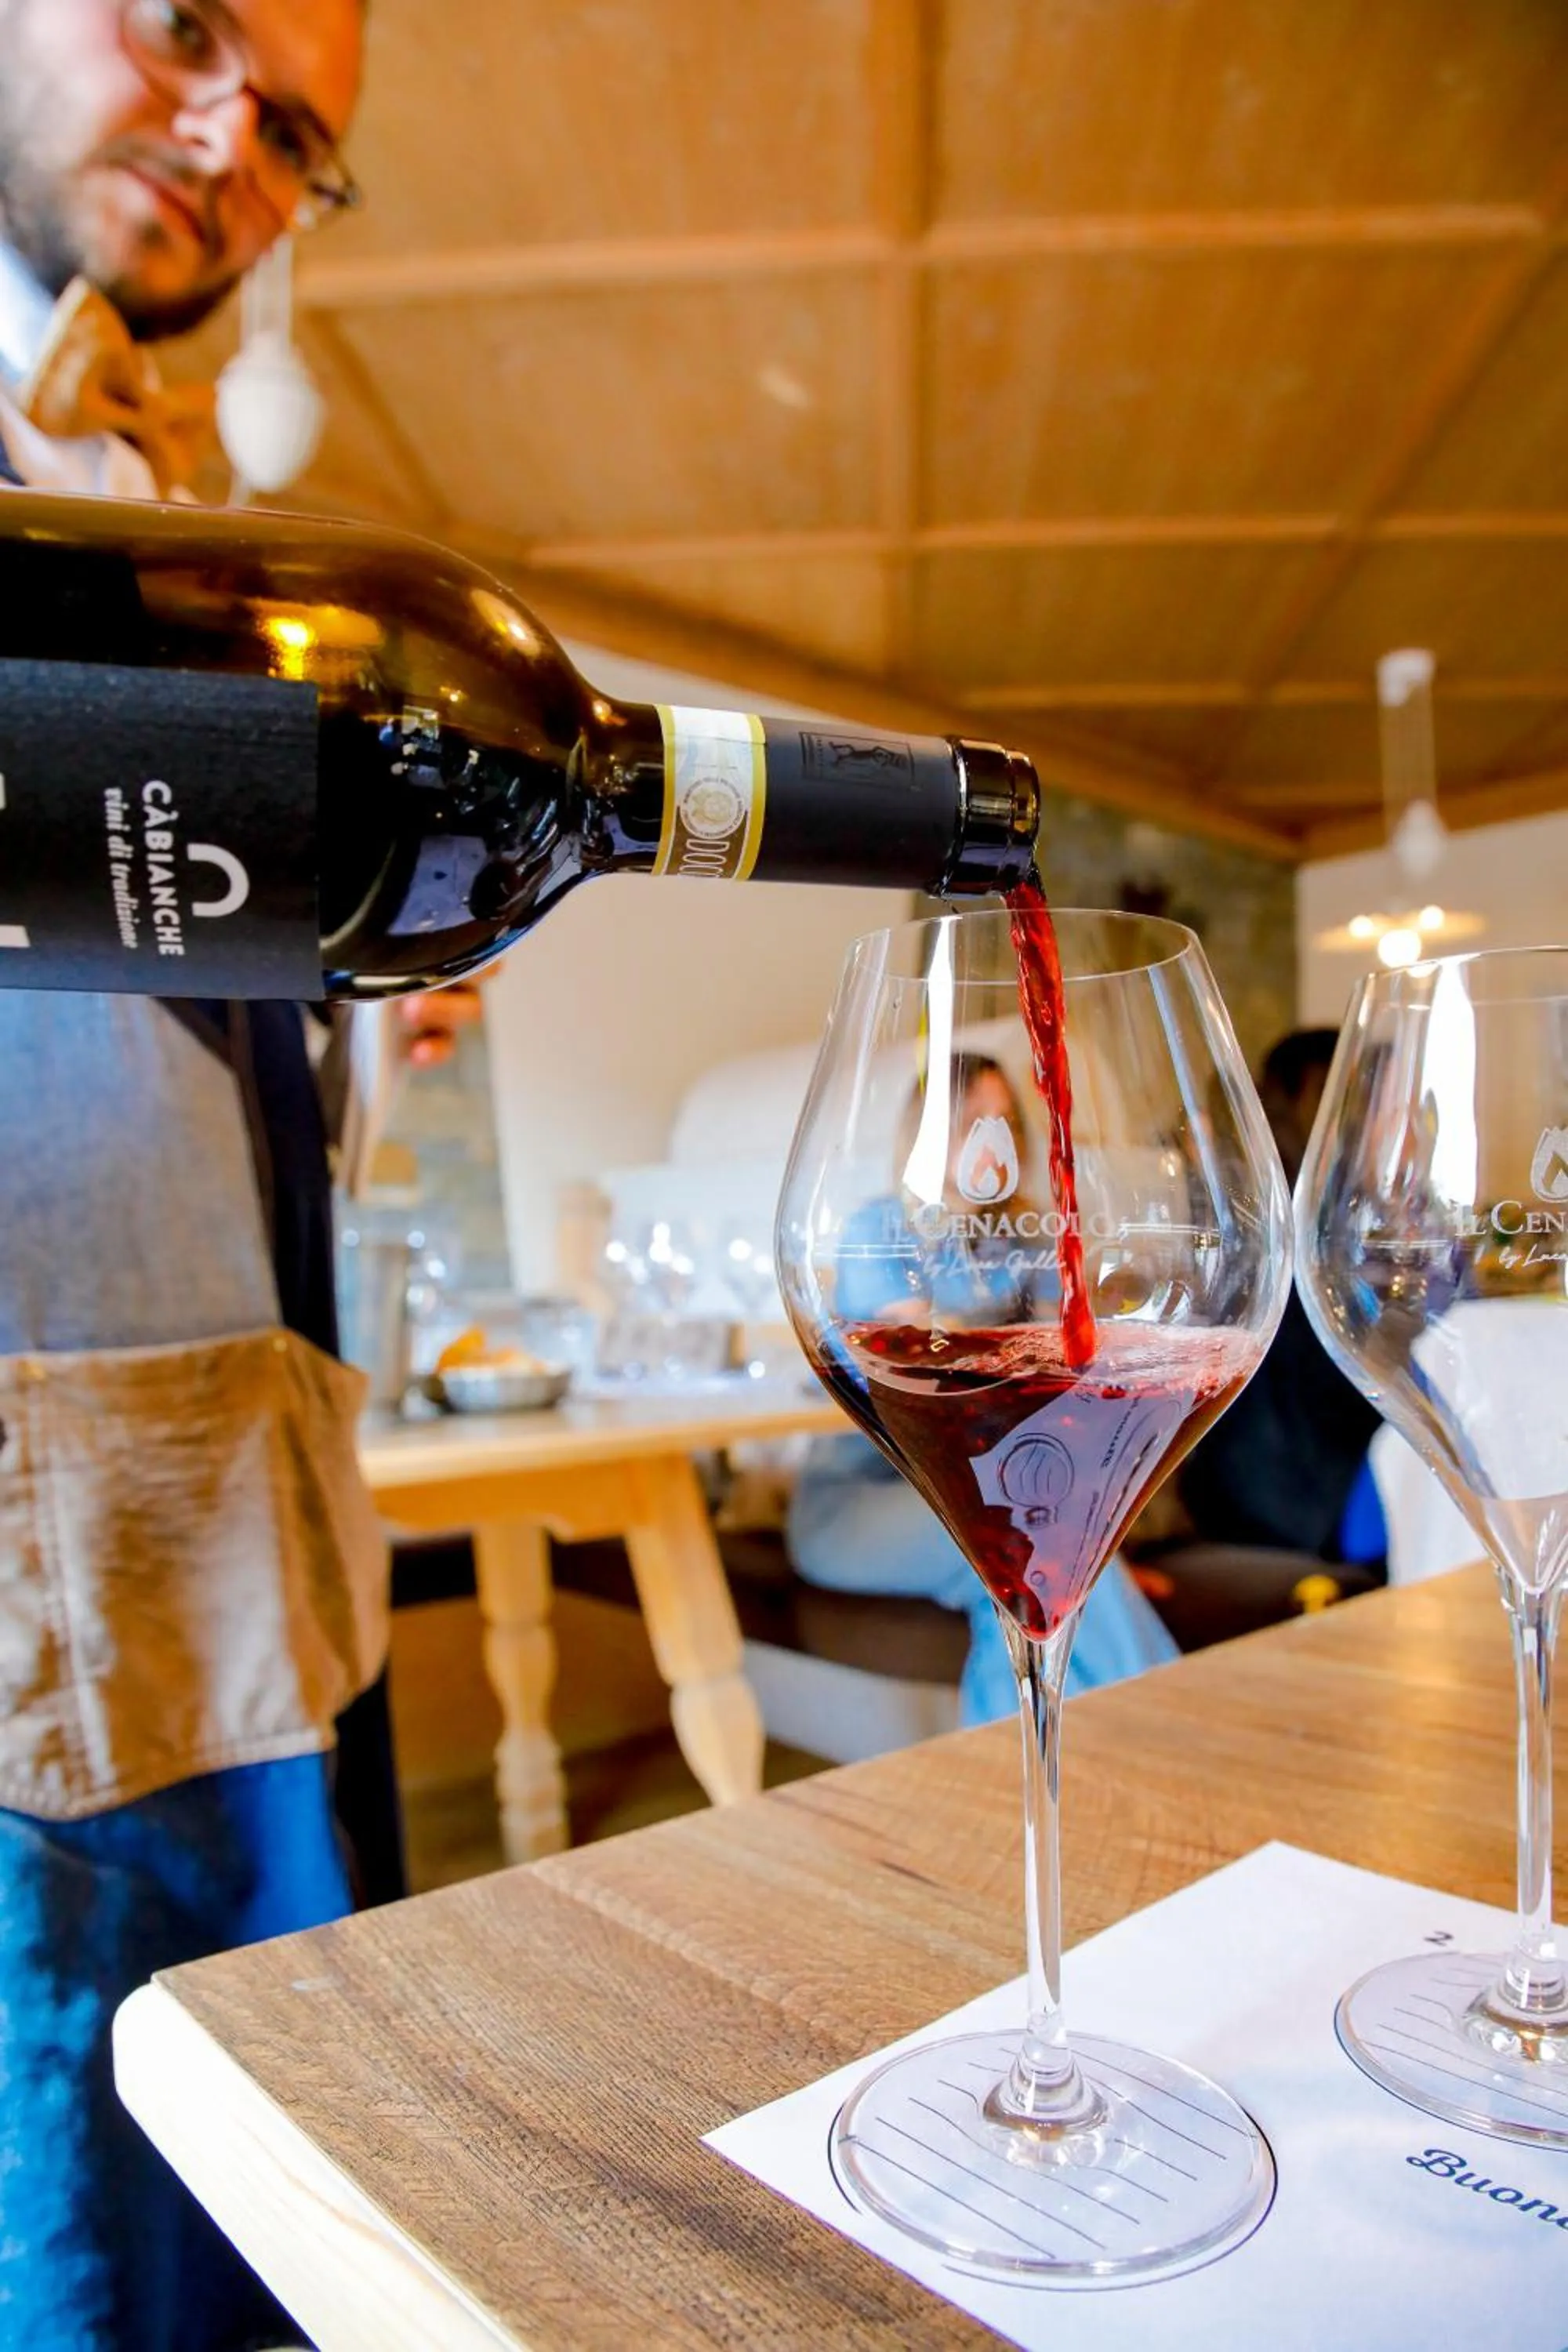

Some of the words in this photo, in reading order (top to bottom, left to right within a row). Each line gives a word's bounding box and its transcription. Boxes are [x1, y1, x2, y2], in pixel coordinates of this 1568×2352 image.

[104, 787, 131, 831] vini
[107, 835, 134, 858] di
[111, 862, 140, 949] tradizione
[1491, 1200, 1568, 1235] CEN
[1498, 1245, 1523, 1269] by
